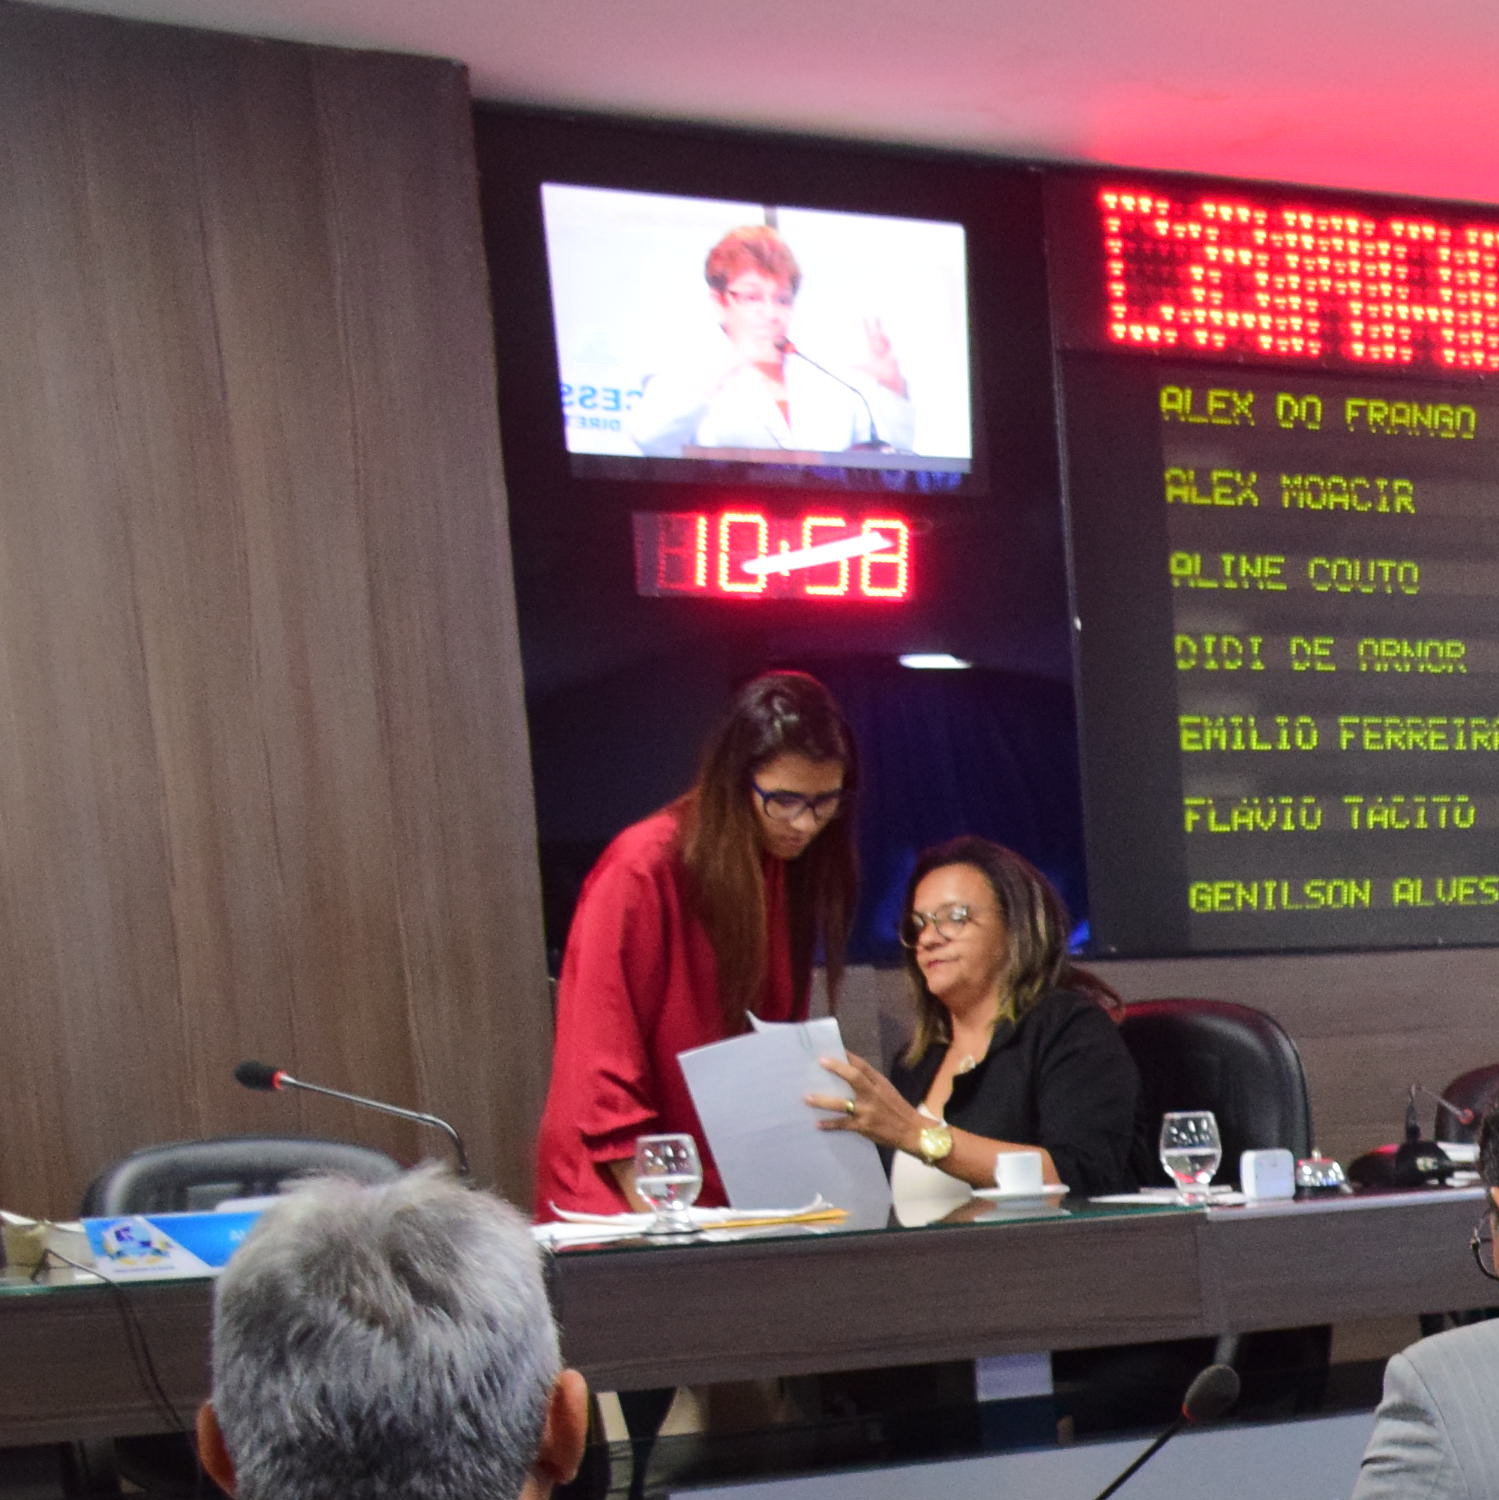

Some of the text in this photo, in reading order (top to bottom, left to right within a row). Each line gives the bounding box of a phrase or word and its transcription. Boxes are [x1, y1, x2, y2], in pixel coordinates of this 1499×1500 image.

[1161, 387, 1255, 425] ALEX
[1277, 394, 1324, 431] DO
[1166, 469, 1417, 514] ALEX MOACIR
[1171, 553, 1421, 596] ALINE COUTO
[1175, 636, 1265, 671] DIDI
[1291, 638, 1337, 673] DE
[1190, 881, 1373, 913] GENILSON
